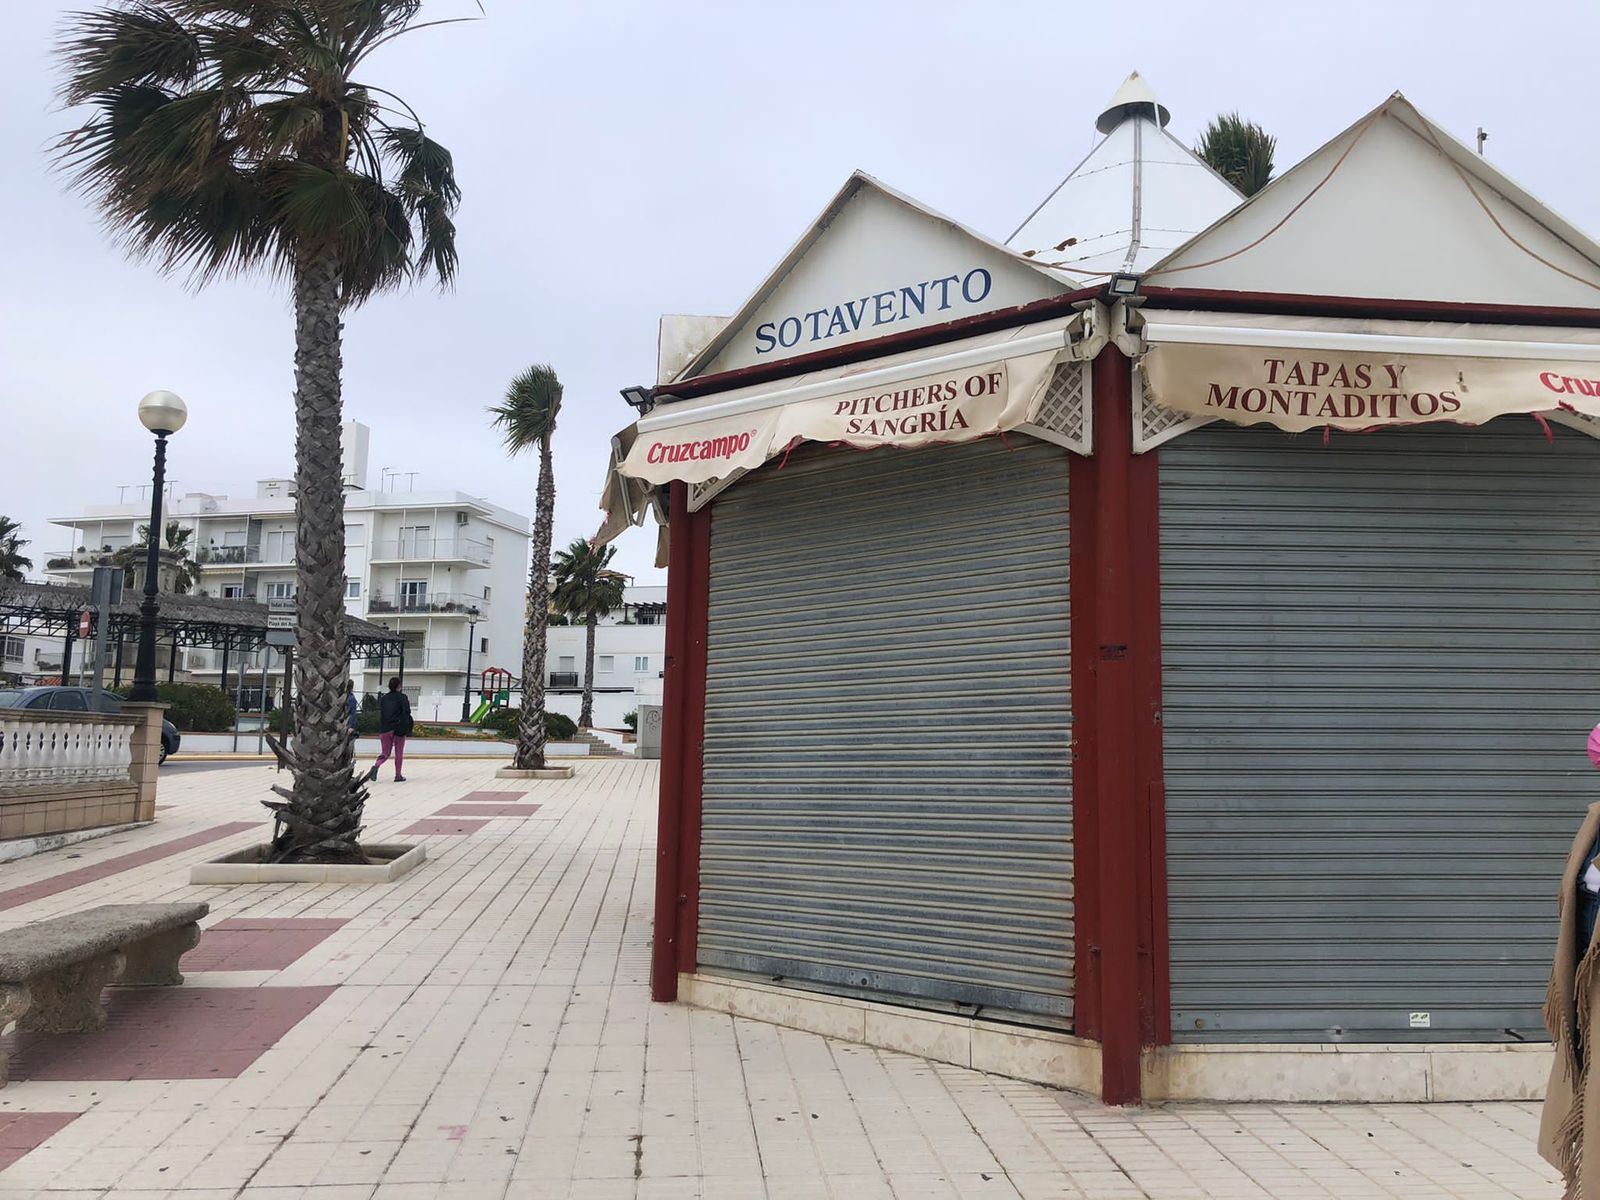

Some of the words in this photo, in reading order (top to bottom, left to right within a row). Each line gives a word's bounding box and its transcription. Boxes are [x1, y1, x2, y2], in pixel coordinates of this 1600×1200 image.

[755, 267, 992, 355] SOTAVENTO
[1263, 358, 1372, 389] TAPAS
[1382, 364, 1407, 389] Y
[833, 380, 957, 416] PITCHERS
[963, 372, 1003, 398] OF
[1204, 382, 1462, 418] MONTADITOS
[845, 404, 969, 436] SANGRÍA
